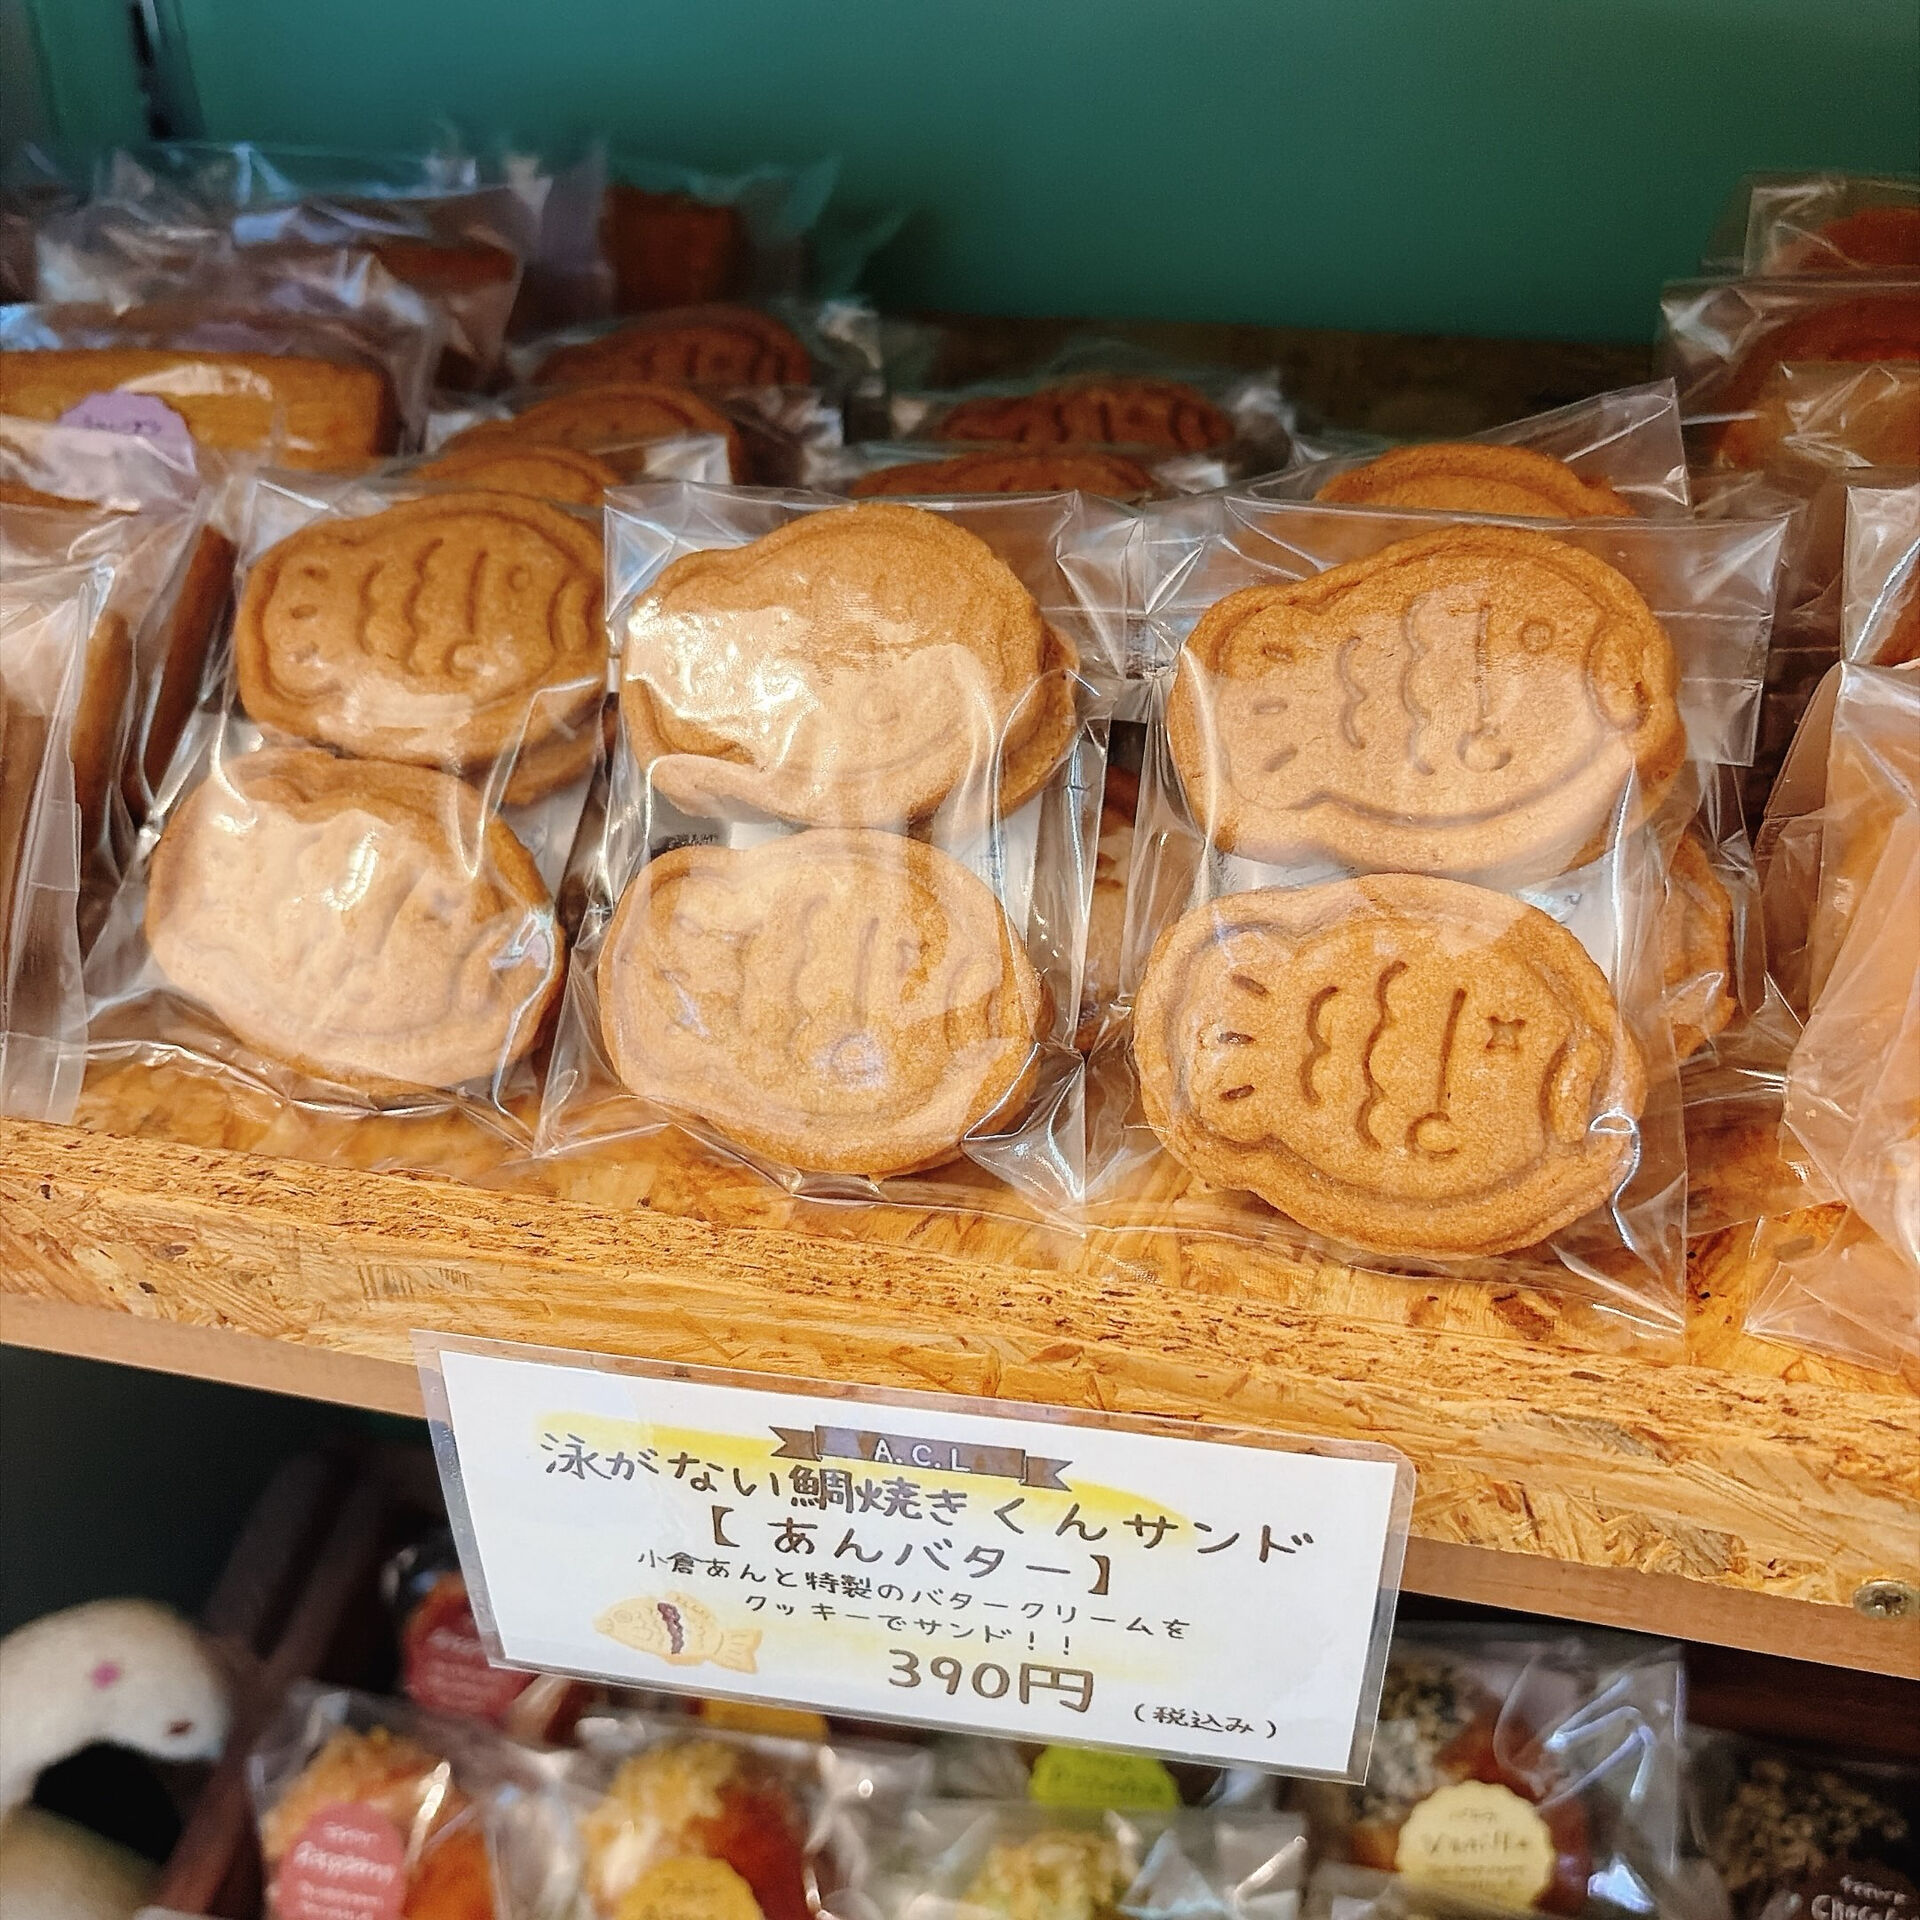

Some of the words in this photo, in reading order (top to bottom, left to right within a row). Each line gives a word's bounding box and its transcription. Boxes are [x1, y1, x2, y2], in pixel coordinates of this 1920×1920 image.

[873, 1438, 972, 1473] A.C.L
[637, 1548, 1192, 1641] 小倉あんと特製のバタークリームを
[887, 1648, 1095, 1714] 390円
